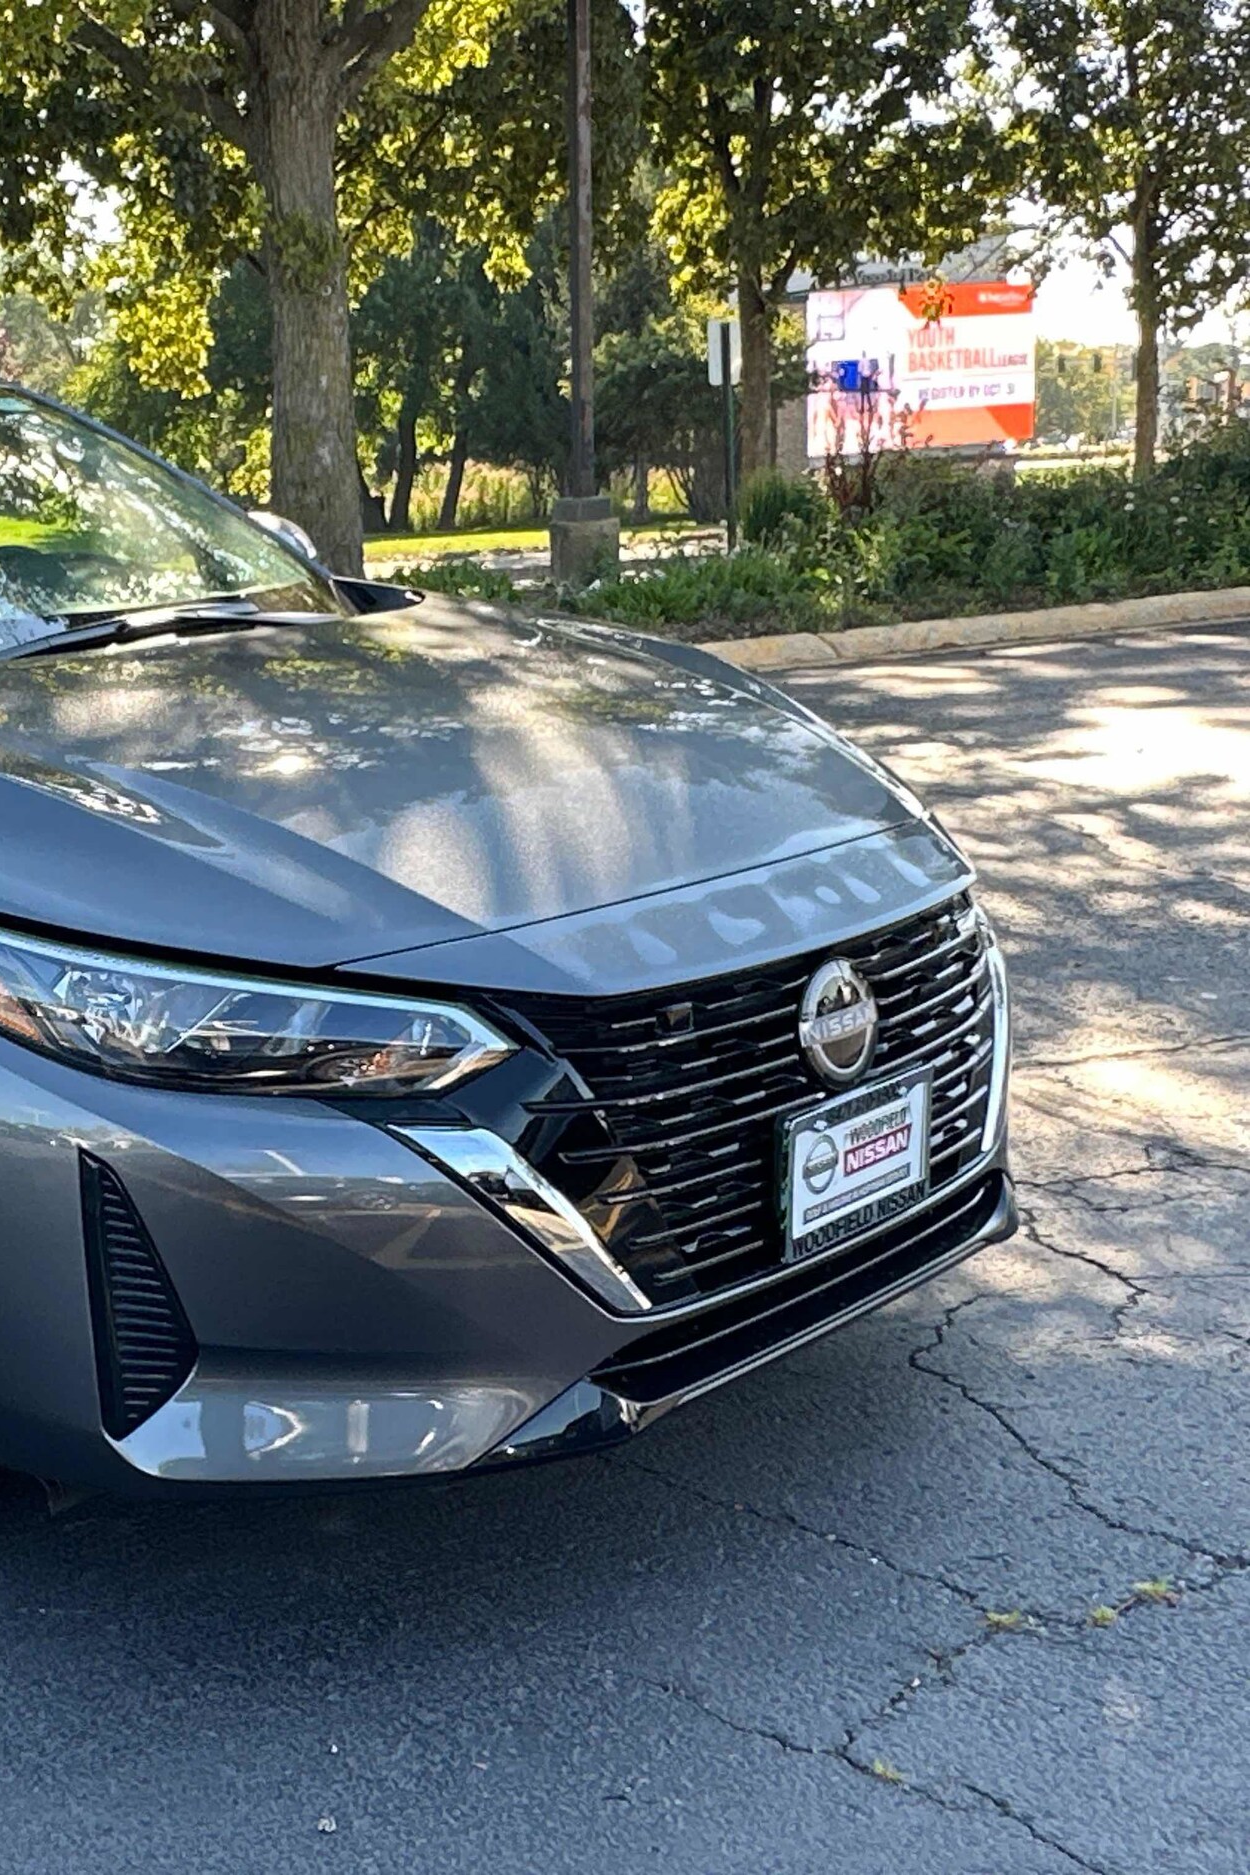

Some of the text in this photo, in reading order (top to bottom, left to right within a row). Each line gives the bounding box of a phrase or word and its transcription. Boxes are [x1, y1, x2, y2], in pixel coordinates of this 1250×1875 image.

[908, 326, 955, 348] YOUTH
[908, 348, 997, 373] BASKETBALL
[846, 1129, 909, 1173] NISSAN
[792, 1200, 875, 1258] WOODFIELD
[877, 1180, 926, 1218] NISSAN
